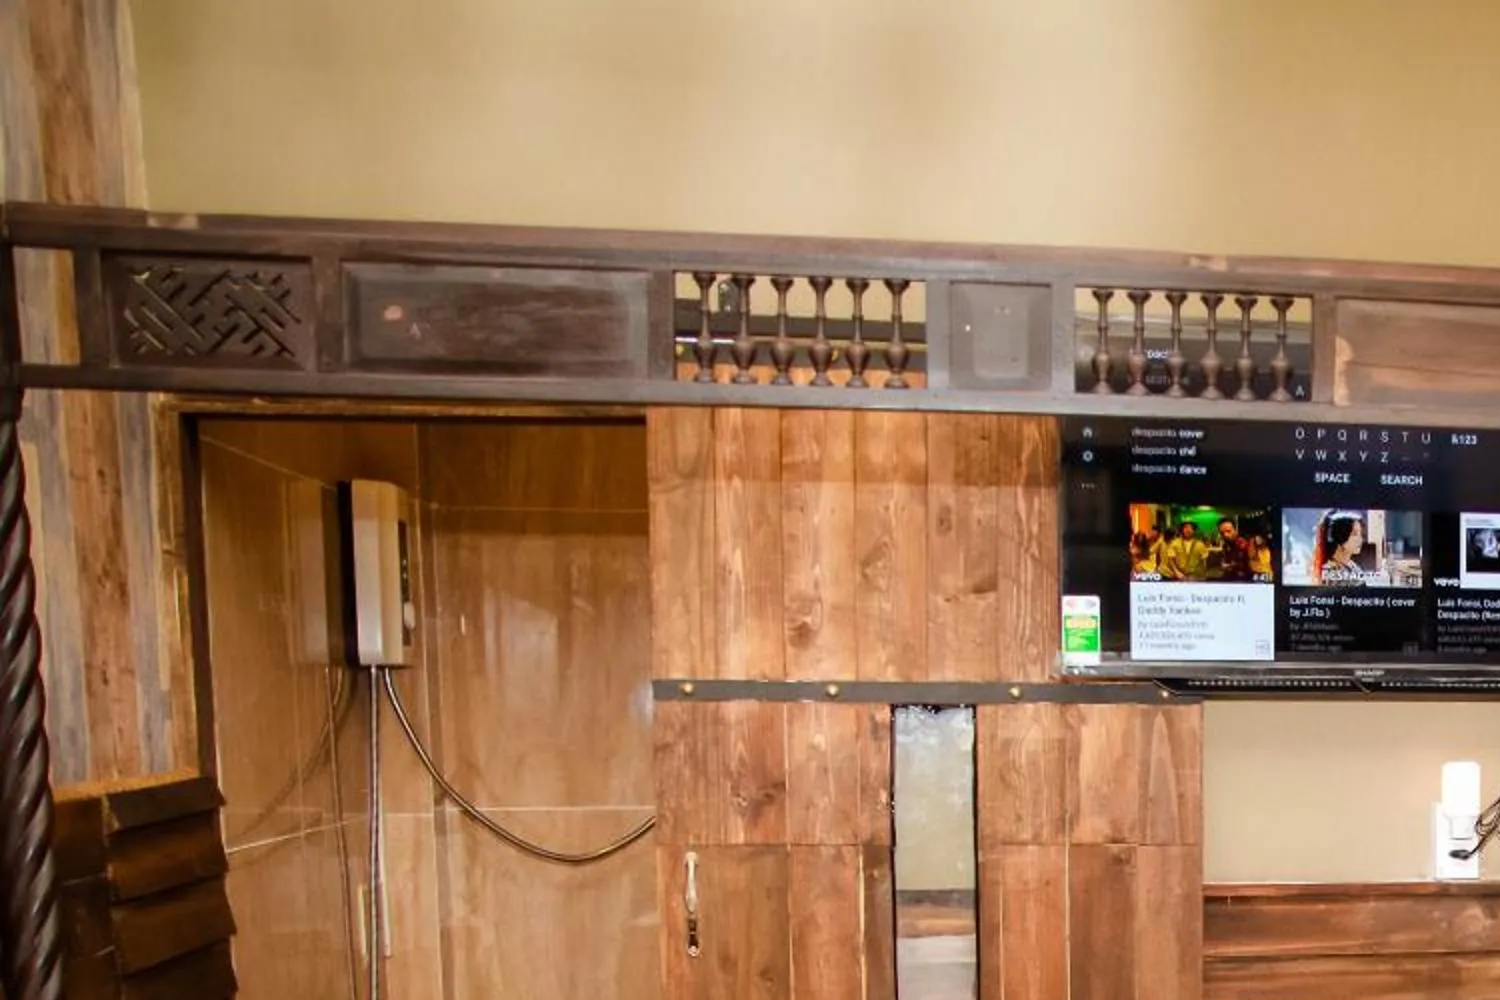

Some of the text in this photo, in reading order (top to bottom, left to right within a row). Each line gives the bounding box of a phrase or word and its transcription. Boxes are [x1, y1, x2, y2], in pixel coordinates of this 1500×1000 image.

[1295, 428, 1305, 440] O
[1317, 429, 1326, 440] P
[1337, 429, 1347, 442] Q
[1359, 430, 1368, 441] R
[1380, 431, 1389, 443] S
[1402, 432, 1410, 443] T
[1421, 432, 1431, 444] U
[1295, 449, 1389, 463] V W X Y Z
[1314, 473, 1350, 483] SPACE
[1380, 474, 1423, 486] SEARCH
